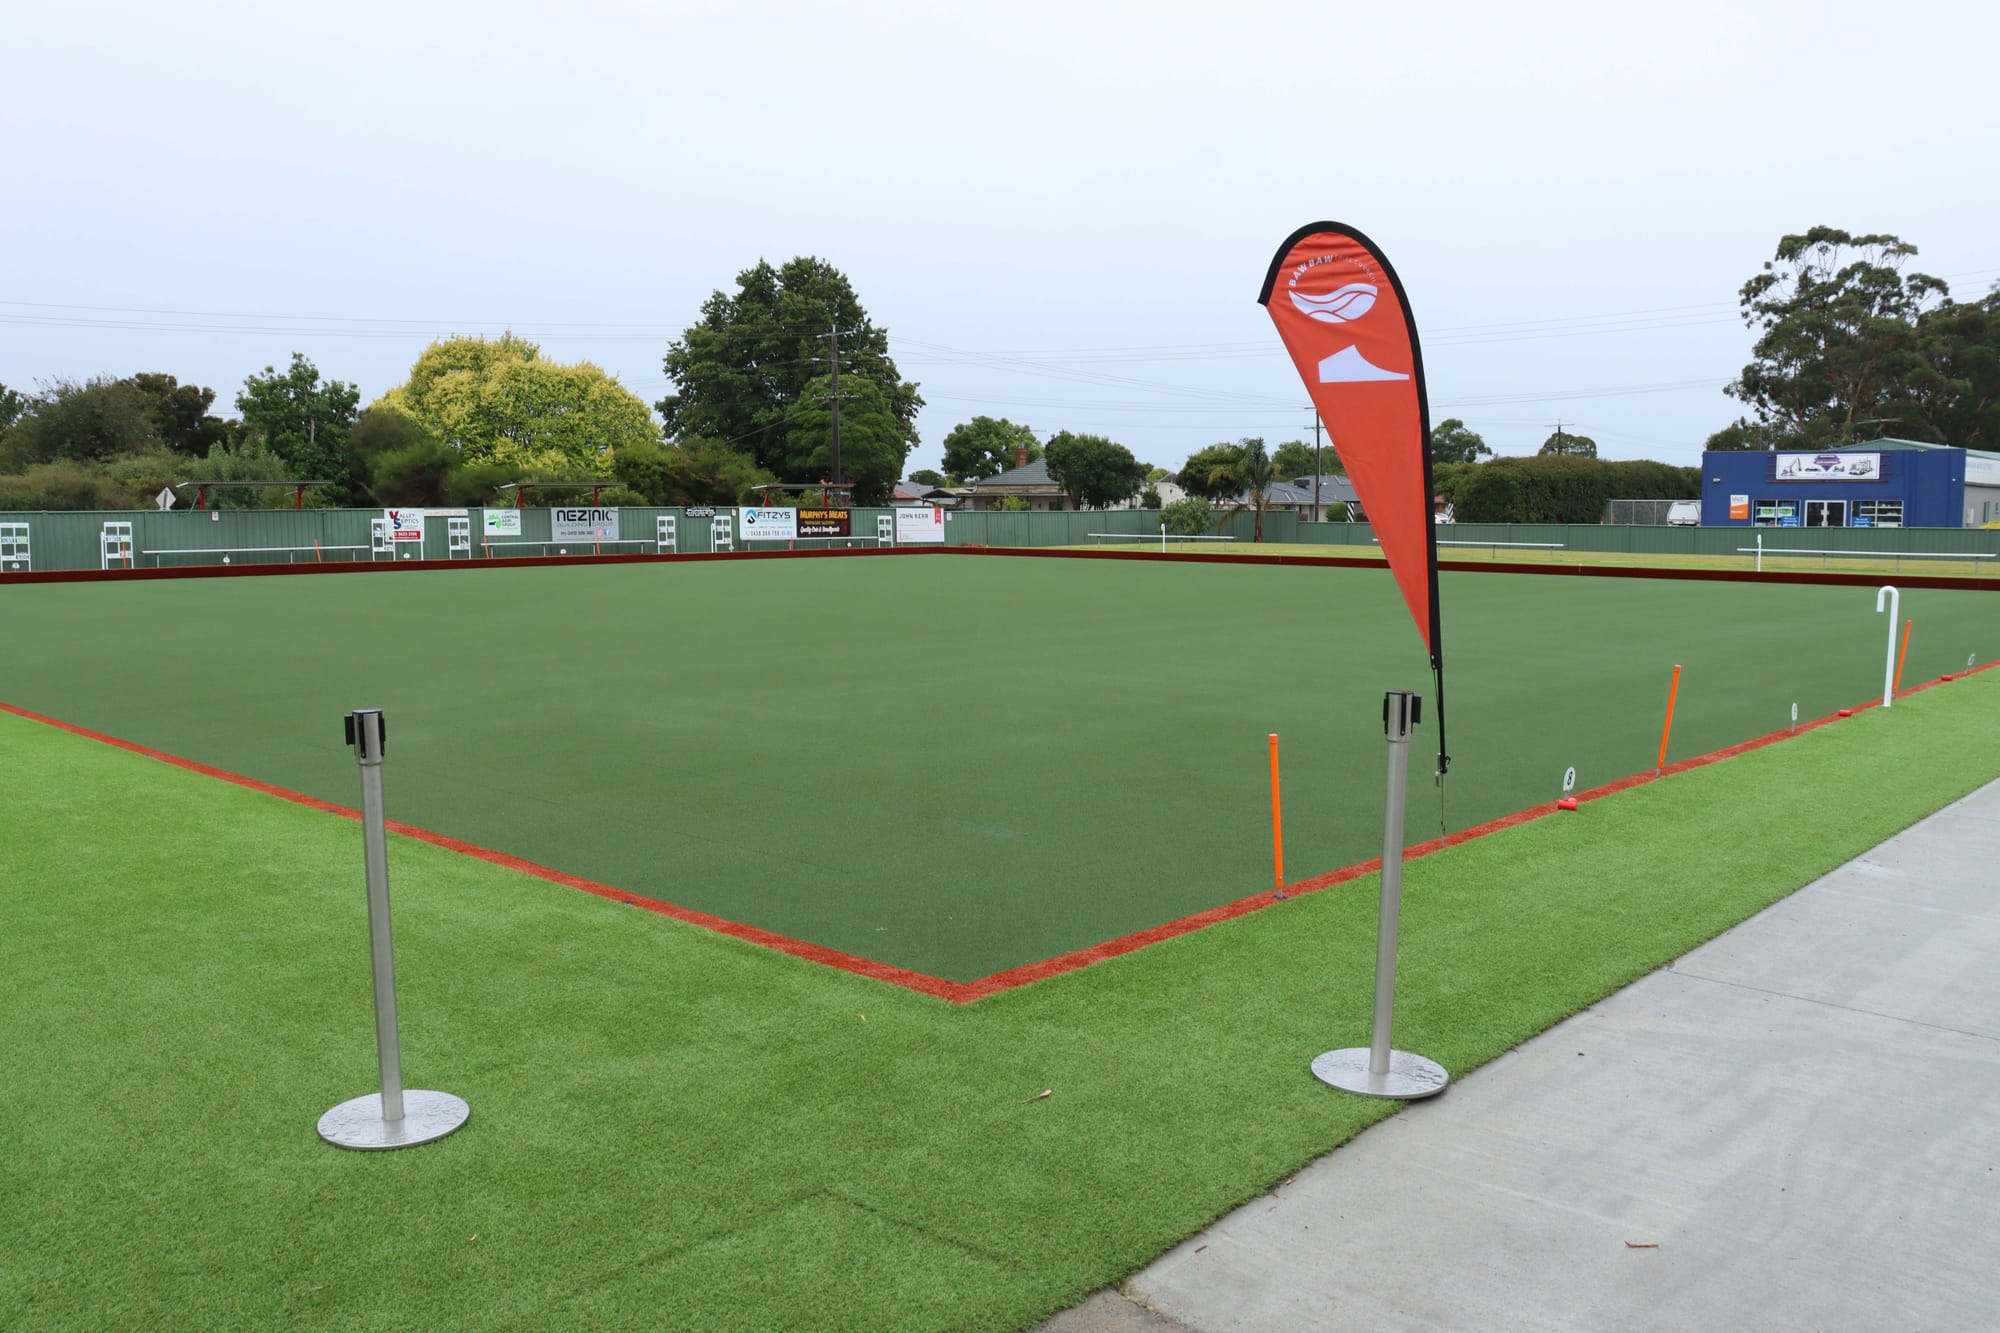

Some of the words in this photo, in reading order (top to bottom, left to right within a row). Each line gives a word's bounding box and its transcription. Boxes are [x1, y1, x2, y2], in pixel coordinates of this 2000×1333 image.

[389, 510, 415, 519] VALLEY
[757, 511, 791, 519] FITZYS
[800, 509, 828, 519] MURPHY'S
[828, 510, 848, 519] MEATS
[393, 518, 419, 529] SEPTICS
